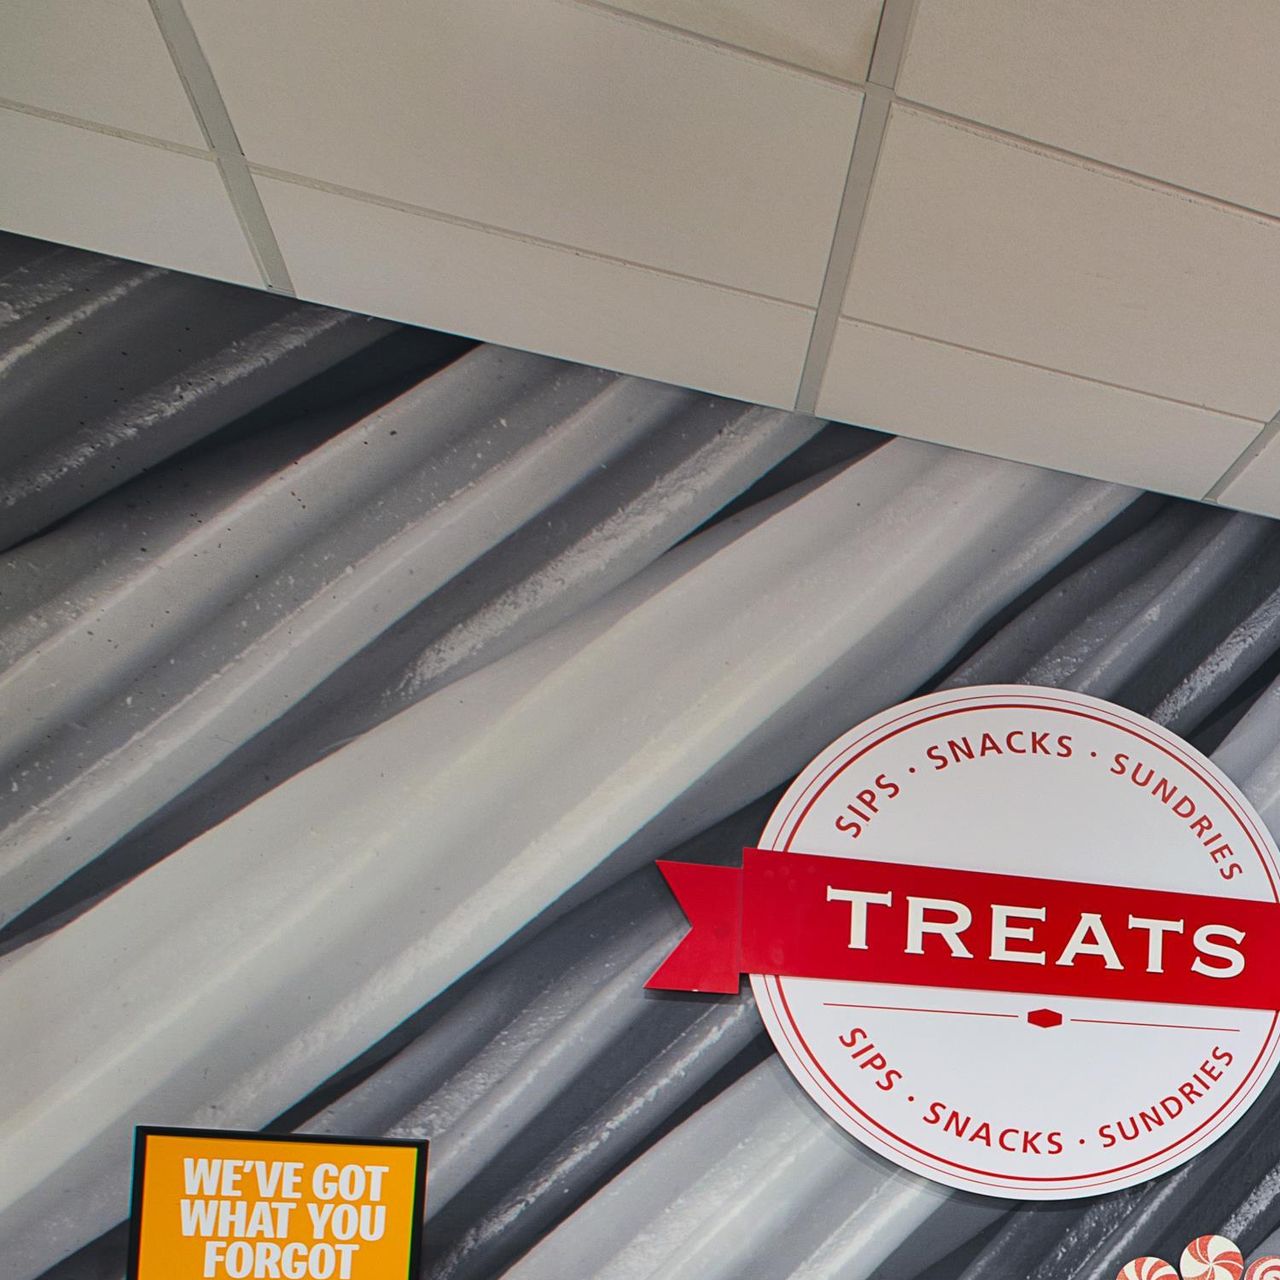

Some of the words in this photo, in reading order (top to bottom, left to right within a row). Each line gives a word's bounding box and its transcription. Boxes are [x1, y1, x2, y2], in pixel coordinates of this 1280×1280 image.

[833, 770, 903, 840] SIPS
[925, 729, 1074, 773] SNACKS
[1108, 750, 1244, 883] SUNDRIES
[825, 885, 1248, 979] TREATS
[837, 1024, 907, 1093] SIPS
[922, 1099, 1065, 1156] SNACKS
[1100, 1045, 1237, 1150] SUNDRIES
[183, 1157, 304, 1199] WE'VE
[312, 1162, 390, 1202] GOT
[180, 1199, 297, 1239] WHAT
[306, 1203, 387, 1242] YOU
[202, 1240, 360, 1280] FORGOT
